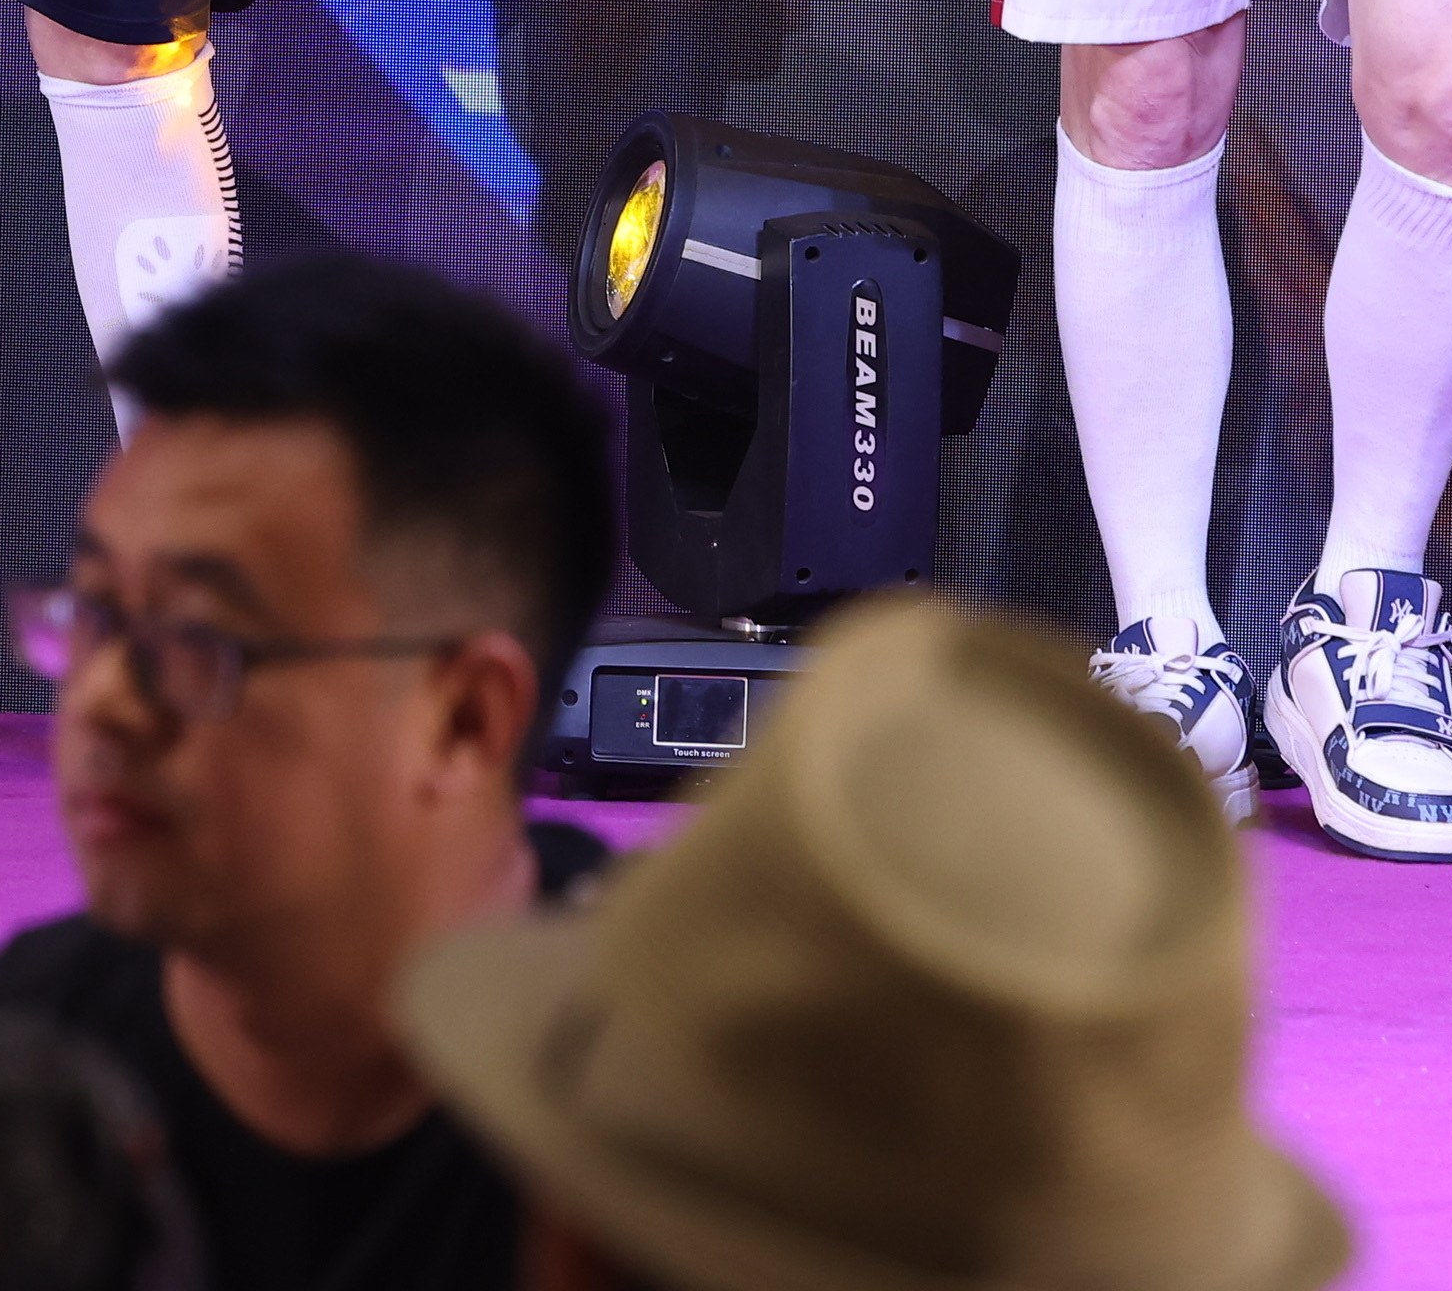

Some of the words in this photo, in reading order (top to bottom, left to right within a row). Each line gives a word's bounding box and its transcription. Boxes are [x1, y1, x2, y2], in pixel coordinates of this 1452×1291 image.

[852, 296, 877, 512] BEAM330
[636, 689, 653, 697] DMX
[673, 748, 700, 758] Touch
[700, 750, 731, 759] screen
